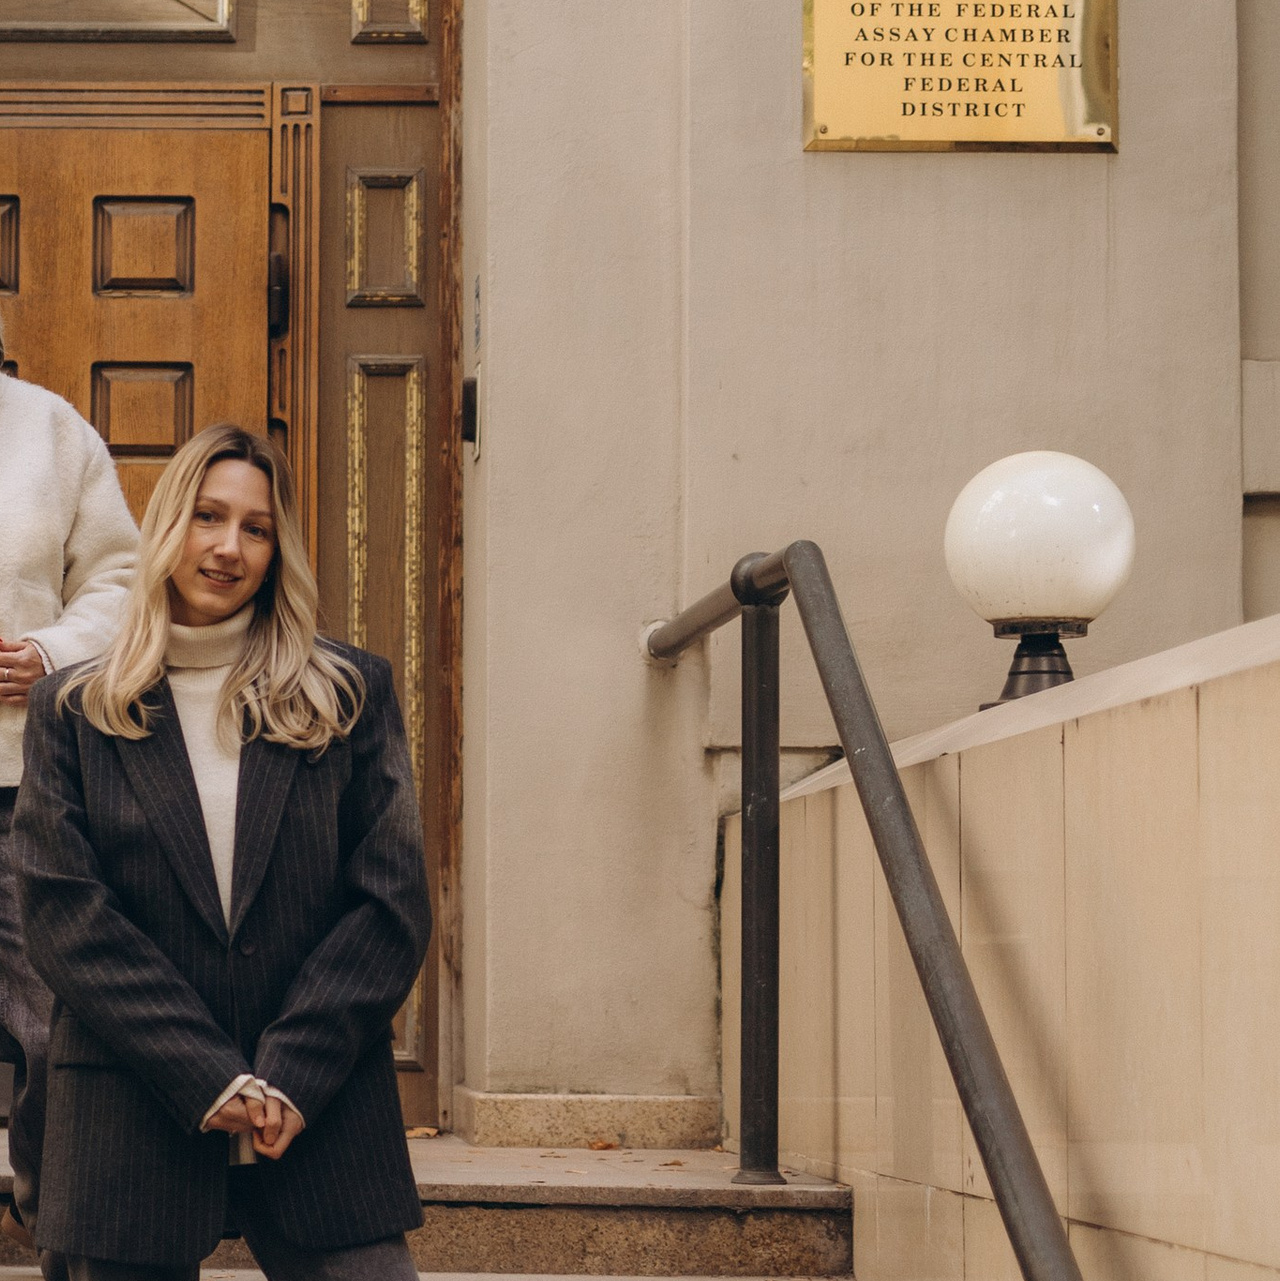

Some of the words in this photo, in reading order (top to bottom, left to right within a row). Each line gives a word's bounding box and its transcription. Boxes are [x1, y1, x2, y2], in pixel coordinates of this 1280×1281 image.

[850, 2, 882, 17] OF
[890, 2, 941, 18] THE
[956, 3, 1076, 19] FEDERAL
[854, 27, 936, 42] ASSAY
[944, 27, 1072, 44] CHAMBER
[844, 51, 895, 67] FOR
[902, 52, 953, 67] THE
[962, 52, 1084, 69] CENTRAL
[904, 77, 1023, 94] FEDERAL
[900, 101, 1027, 118] DISTRICT
